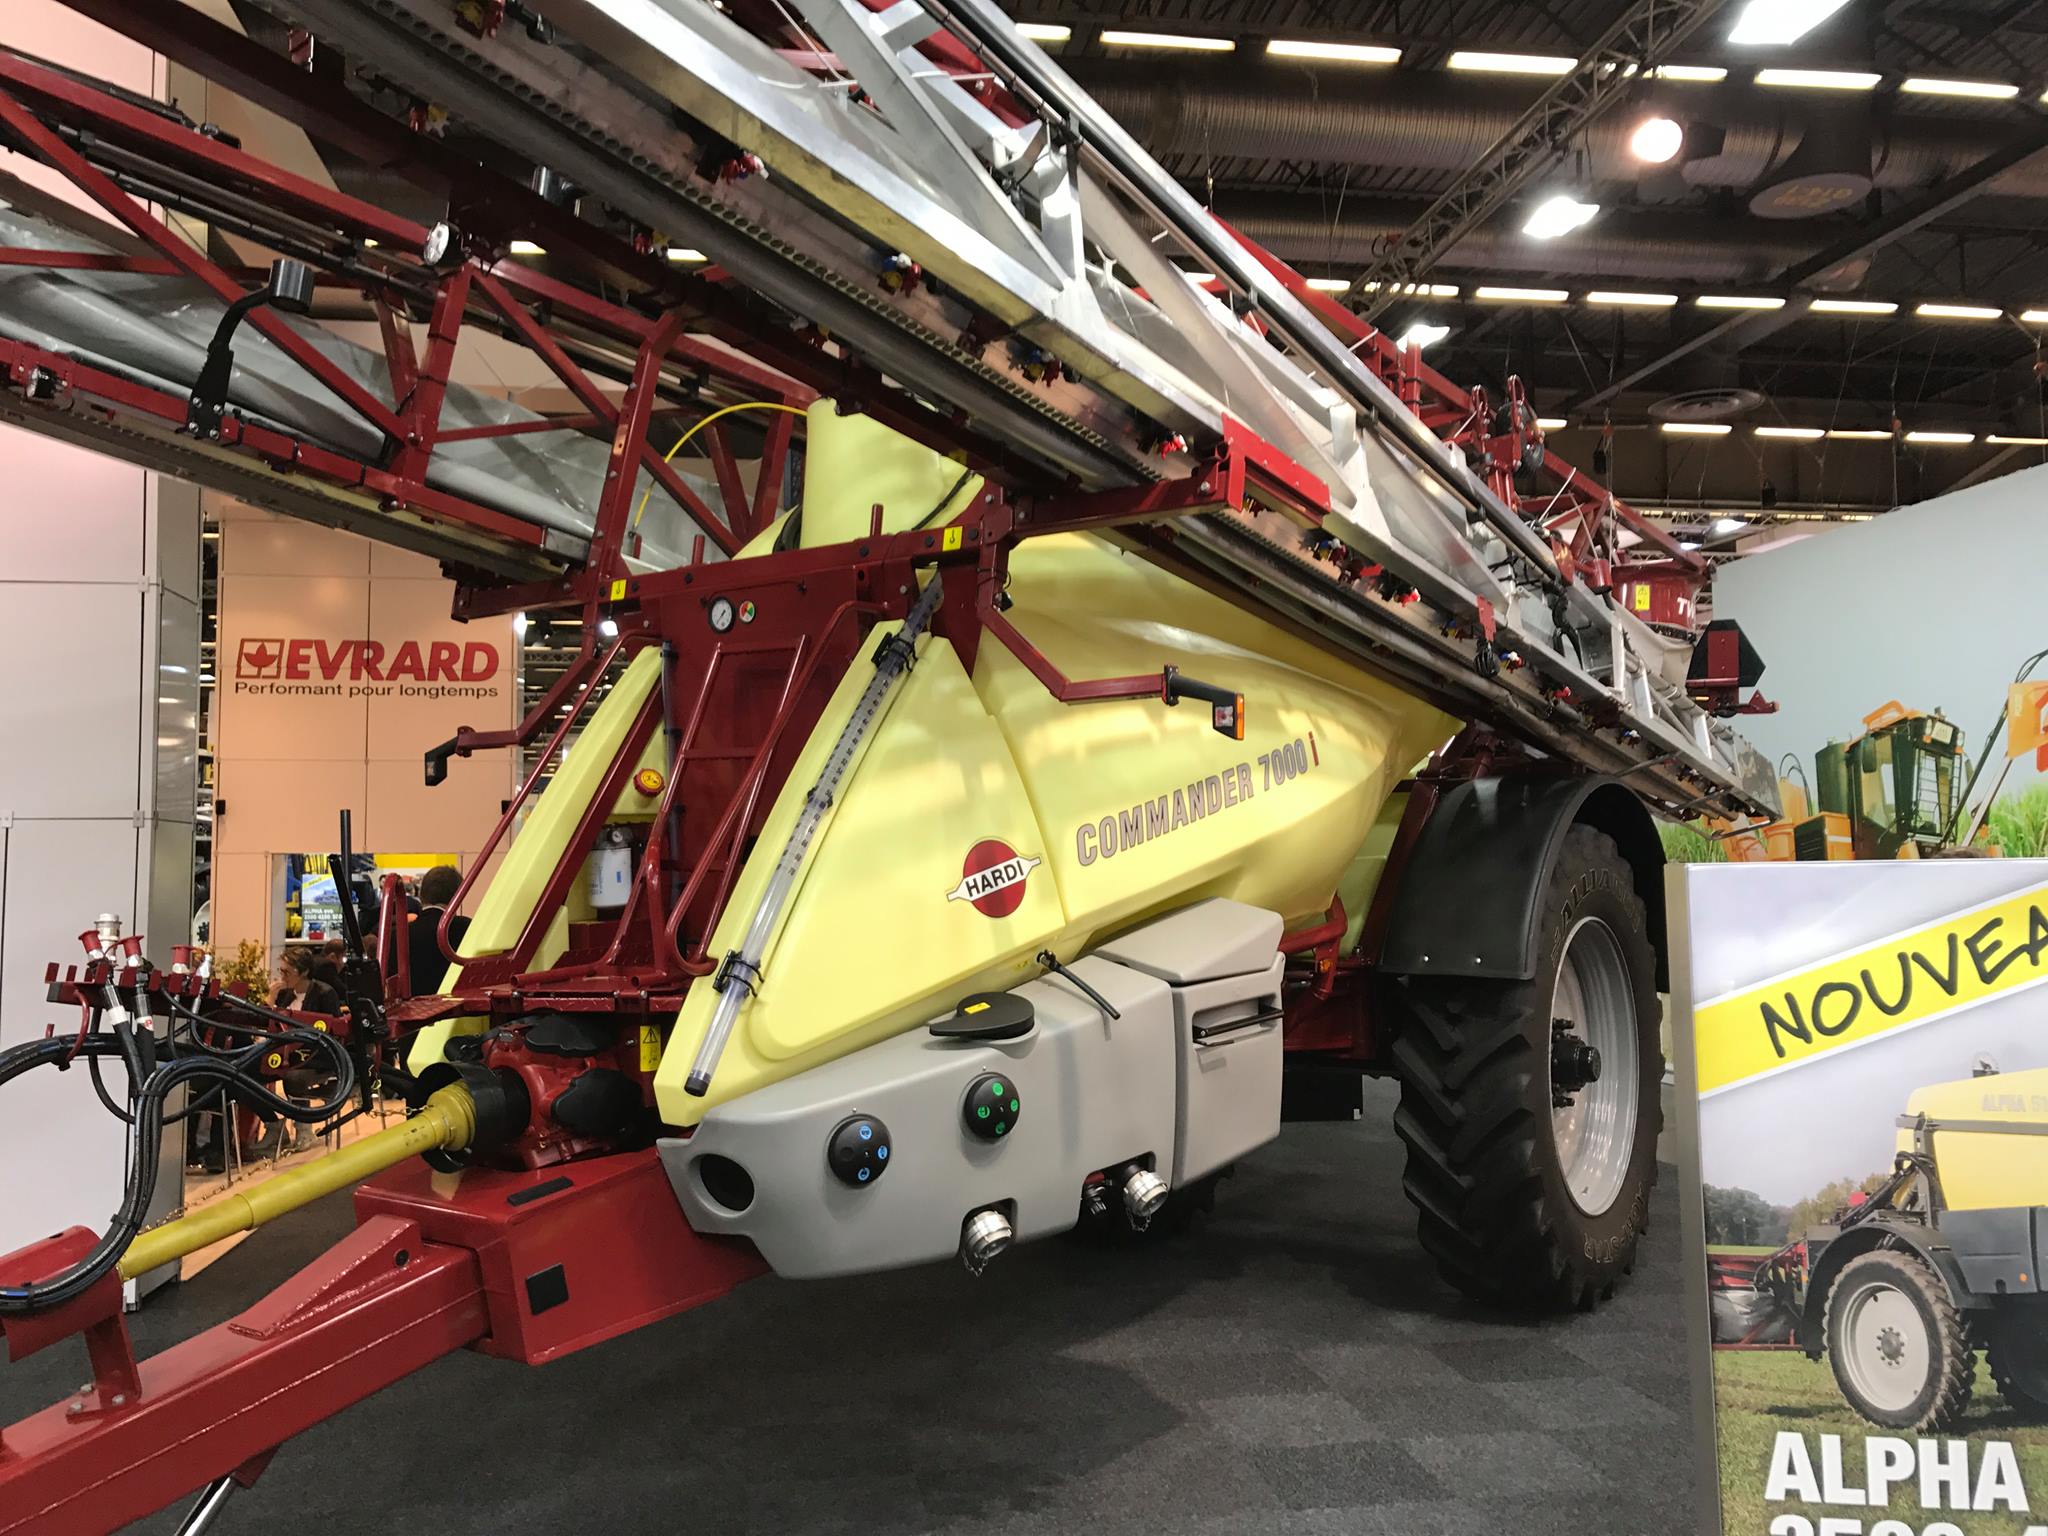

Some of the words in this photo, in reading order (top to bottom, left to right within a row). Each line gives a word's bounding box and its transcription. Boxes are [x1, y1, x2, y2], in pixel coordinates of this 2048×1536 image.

[285, 639, 500, 682] EVRARD
[234, 681, 343, 696] Performant
[349, 684, 394, 698] pour
[399, 683, 499, 699] longtemps
[1076, 762, 1254, 866] COMMANDER
[1258, 738, 1308, 792] 7000
[965, 860, 1024, 897] HARDI
[1764, 1431, 2030, 1513] ALPHA
